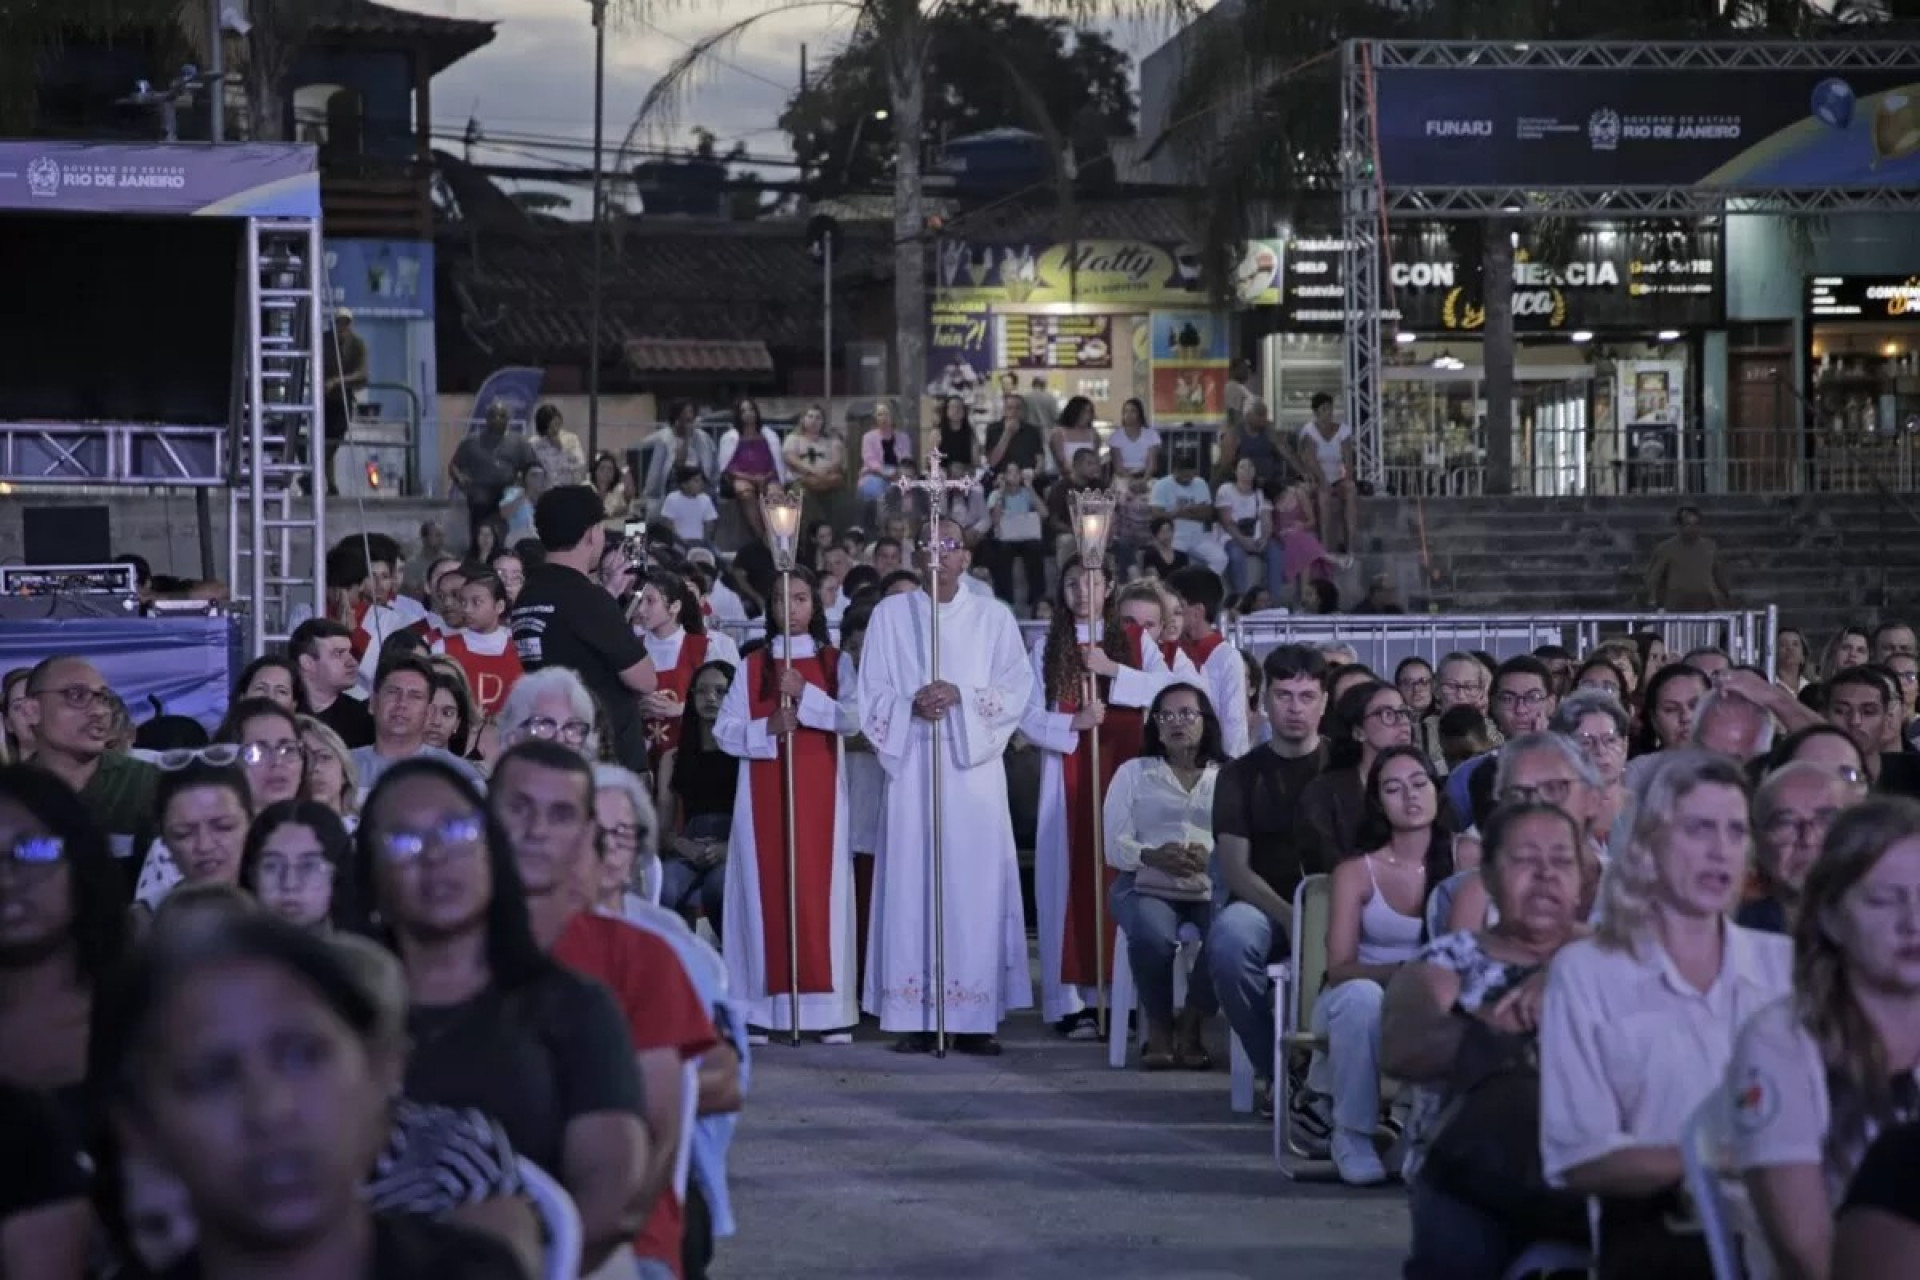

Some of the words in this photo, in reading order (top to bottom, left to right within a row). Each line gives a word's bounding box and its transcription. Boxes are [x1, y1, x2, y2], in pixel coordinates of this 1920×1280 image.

[1425, 119, 1493, 137] FUNARJ
[1623, 125, 1651, 138] RIO
[1652, 125, 1674, 138] DE
[1676, 125, 1741, 139] JANEIRO
[63, 172, 93, 186] RIO
[95, 173, 116, 187] DE
[118, 174, 185, 188] JANEIRO
